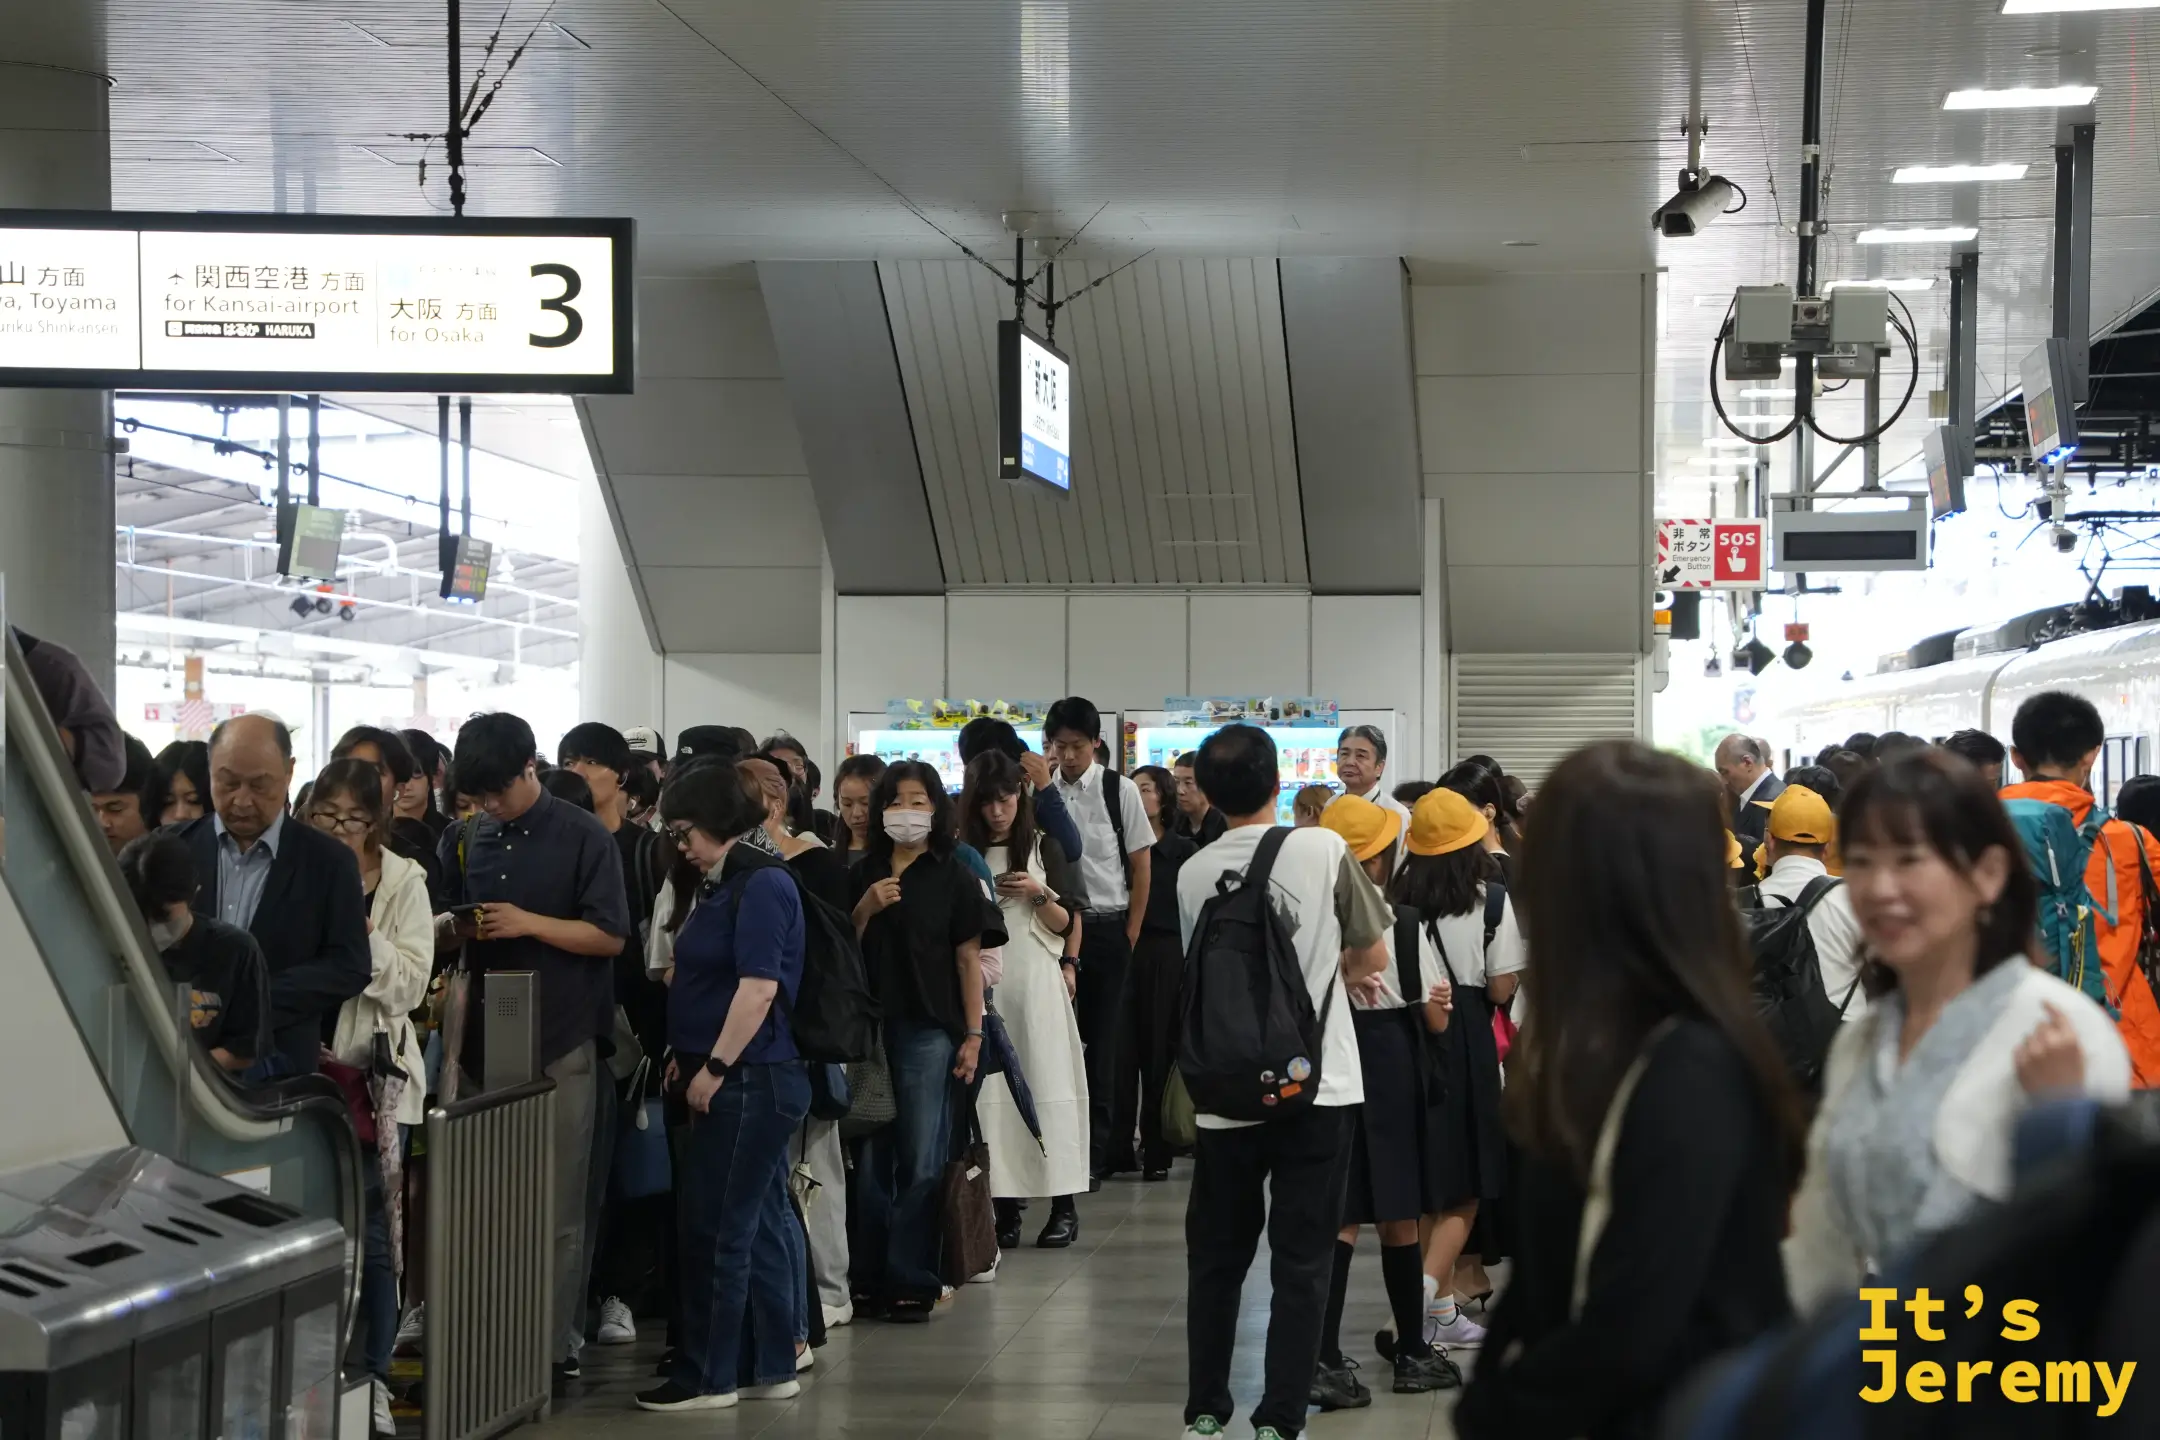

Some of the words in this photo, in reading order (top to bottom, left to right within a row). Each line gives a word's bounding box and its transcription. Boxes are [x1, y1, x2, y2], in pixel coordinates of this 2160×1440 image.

[0, 261, 24, 285] 山
[38, 267, 84, 287] 方面
[196, 265, 308, 290] 関西空港
[320, 272, 364, 291] 方面
[0, 297, 21, 310] a,
[30, 292, 115, 314] Toyama
[164, 293, 196, 312] for
[204, 296, 359, 318] Kansai-airport
[390, 297, 442, 320] 大阪
[456, 303, 496, 320] 方面
[529, 263, 583, 348] 3
[36, 319, 118, 334] Shinkansen
[223, 323, 260, 337] はるか
[265, 325, 312, 337] HARUKA
[390, 325, 416, 343] for
[425, 326, 484, 344] Osaka
[1673, 541, 1711, 552] ボタン
[1719, 532, 1756, 546] SOS
[1672, 555, 1711, 563] Emergency
[1687, 562, 1711, 570] Button
